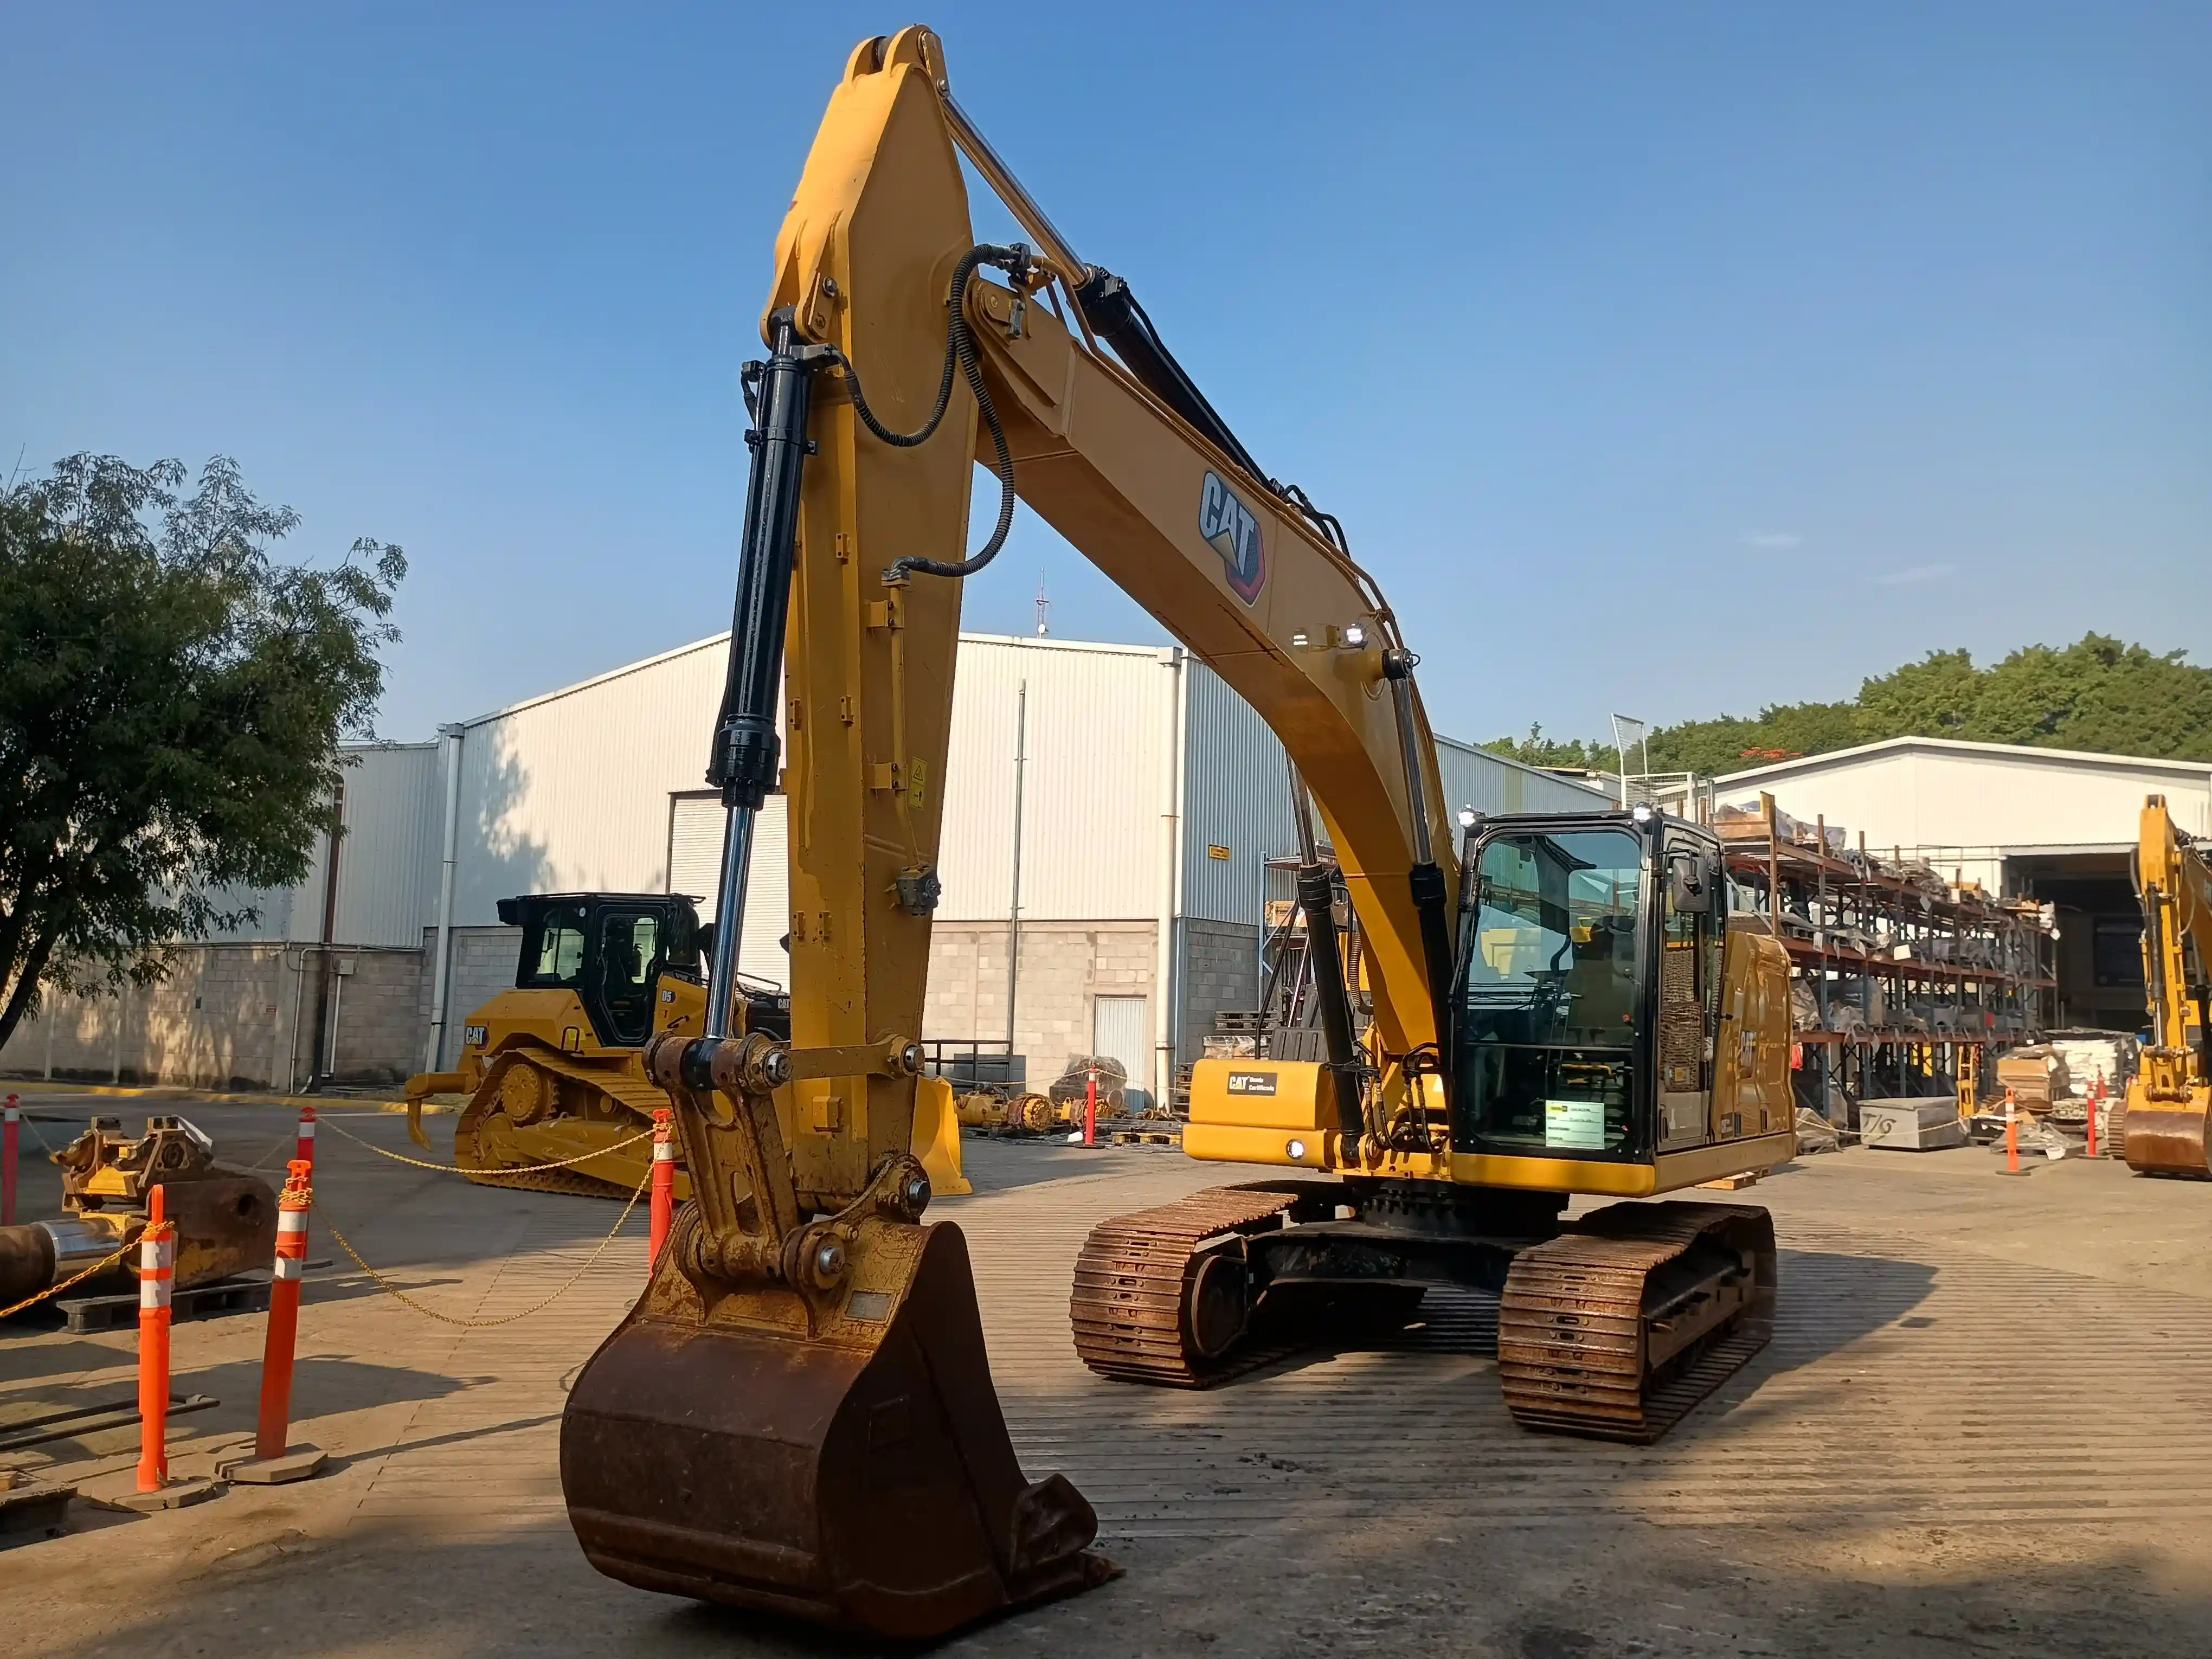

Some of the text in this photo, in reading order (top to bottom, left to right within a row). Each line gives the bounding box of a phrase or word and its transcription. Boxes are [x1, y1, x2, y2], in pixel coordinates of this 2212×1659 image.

[1199, 472, 1255, 576] CAT
[661, 991, 672, 1002] D5
[777, 998, 790, 1008] CAT
[466, 1027, 485, 1045] CAT
[1229, 1076, 1250, 1090] CAT
